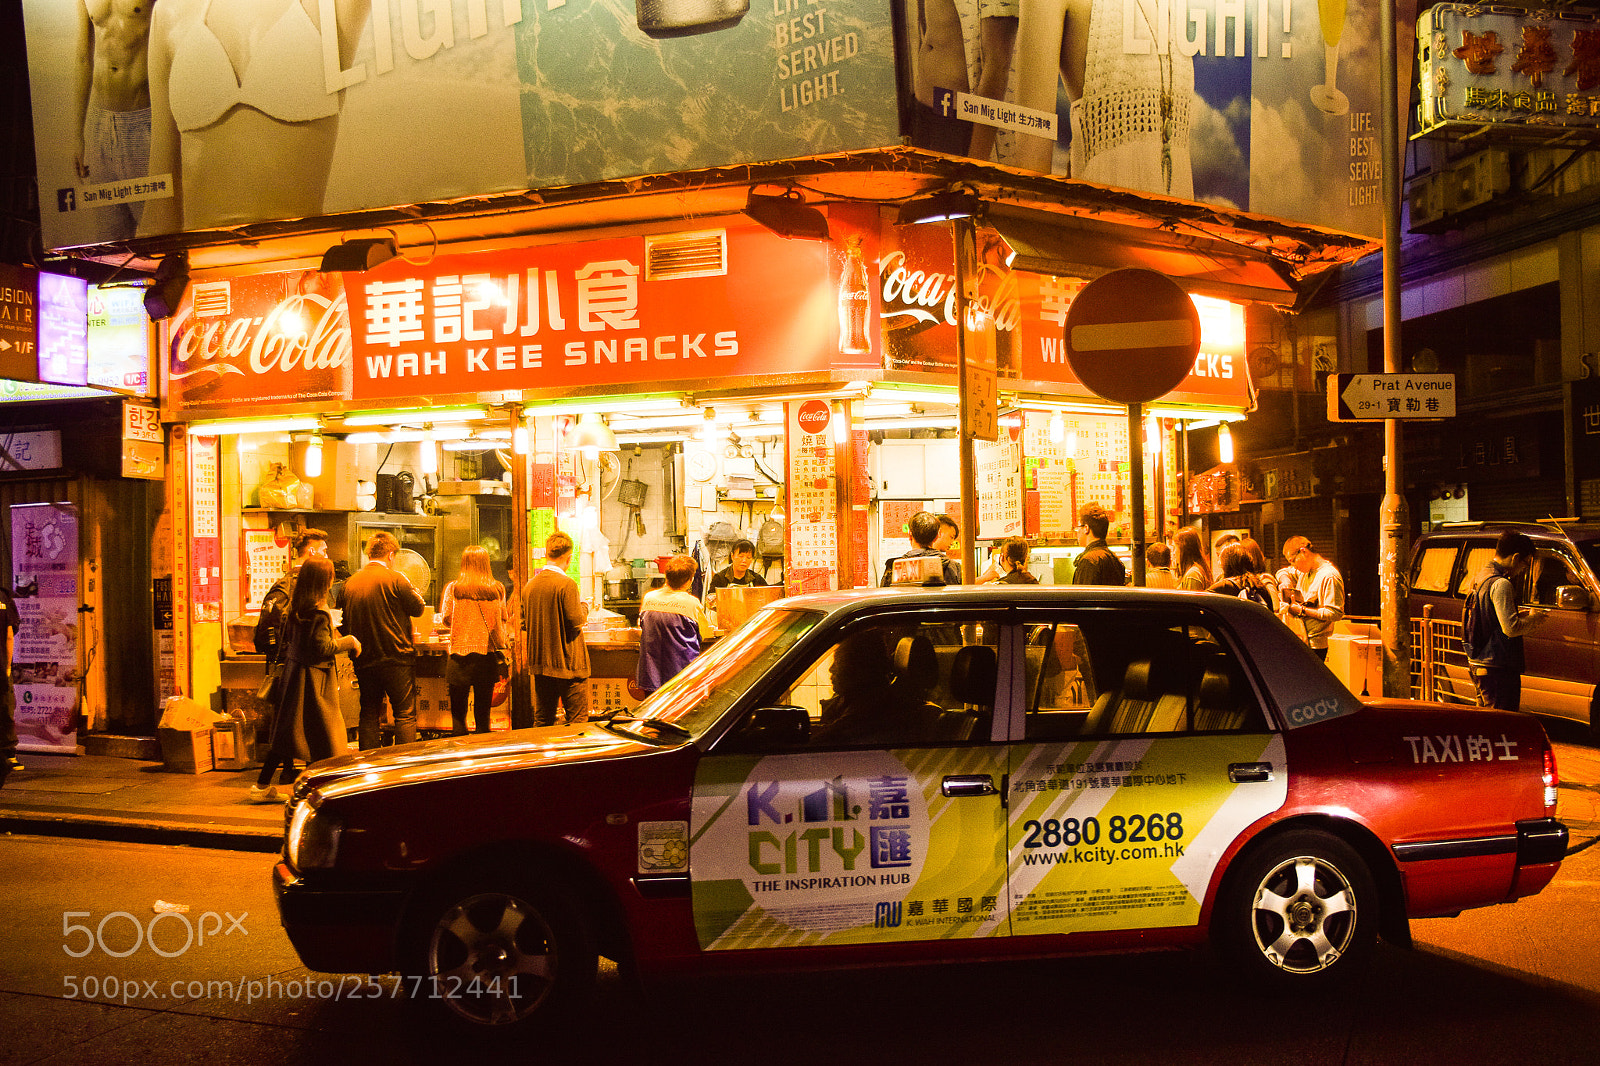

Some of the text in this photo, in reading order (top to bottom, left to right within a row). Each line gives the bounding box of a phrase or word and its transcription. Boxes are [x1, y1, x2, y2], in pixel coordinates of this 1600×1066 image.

[775, 8, 826, 48] BEST
[777, 32, 858, 80] SERVED
[780, 69, 845, 113] LIGHT.
[963, 100, 979, 115] San
[980, 104, 995, 120] Mig
[997, 108, 1017, 124] Light
[1019, 112, 1052, 132] 生力清啤
[1350, 112, 1375, 132] LIFE.
[1350, 136, 1375, 157] BEST
[1349, 160, 1383, 181] SERVE
[84, 191, 97, 202] San
[99, 189, 112, 201] Mig
[113, 185, 132, 199] Light
[1349, 185, 1379, 207] LIGHT.
[365, 259, 640, 347] 華記小食
[14, 341, 34, 354] 1/F
[366, 330, 739, 378] WAH KEE SNACKS
[1373, 379, 1453, 391] Prat Avenue
[1387, 397, 1440, 412] 寶勒巷
[894, 559, 922, 582] TAXI
[1291, 698, 1339, 723] cody
[1403, 734, 1519, 764] TAXI 的士
[1023, 812, 1184, 849] 2880 8268
[749, 826, 865, 875] CITY
[1023, 842, 1185, 866] www.kcity.com.hk
[752, 872, 911, 892] THE INSPIRATION HUB
[907, 896, 997, 917] 嘉華國際
[915, 918, 935, 926] WAH
[936, 914, 996, 925] INTERNATIONAL
